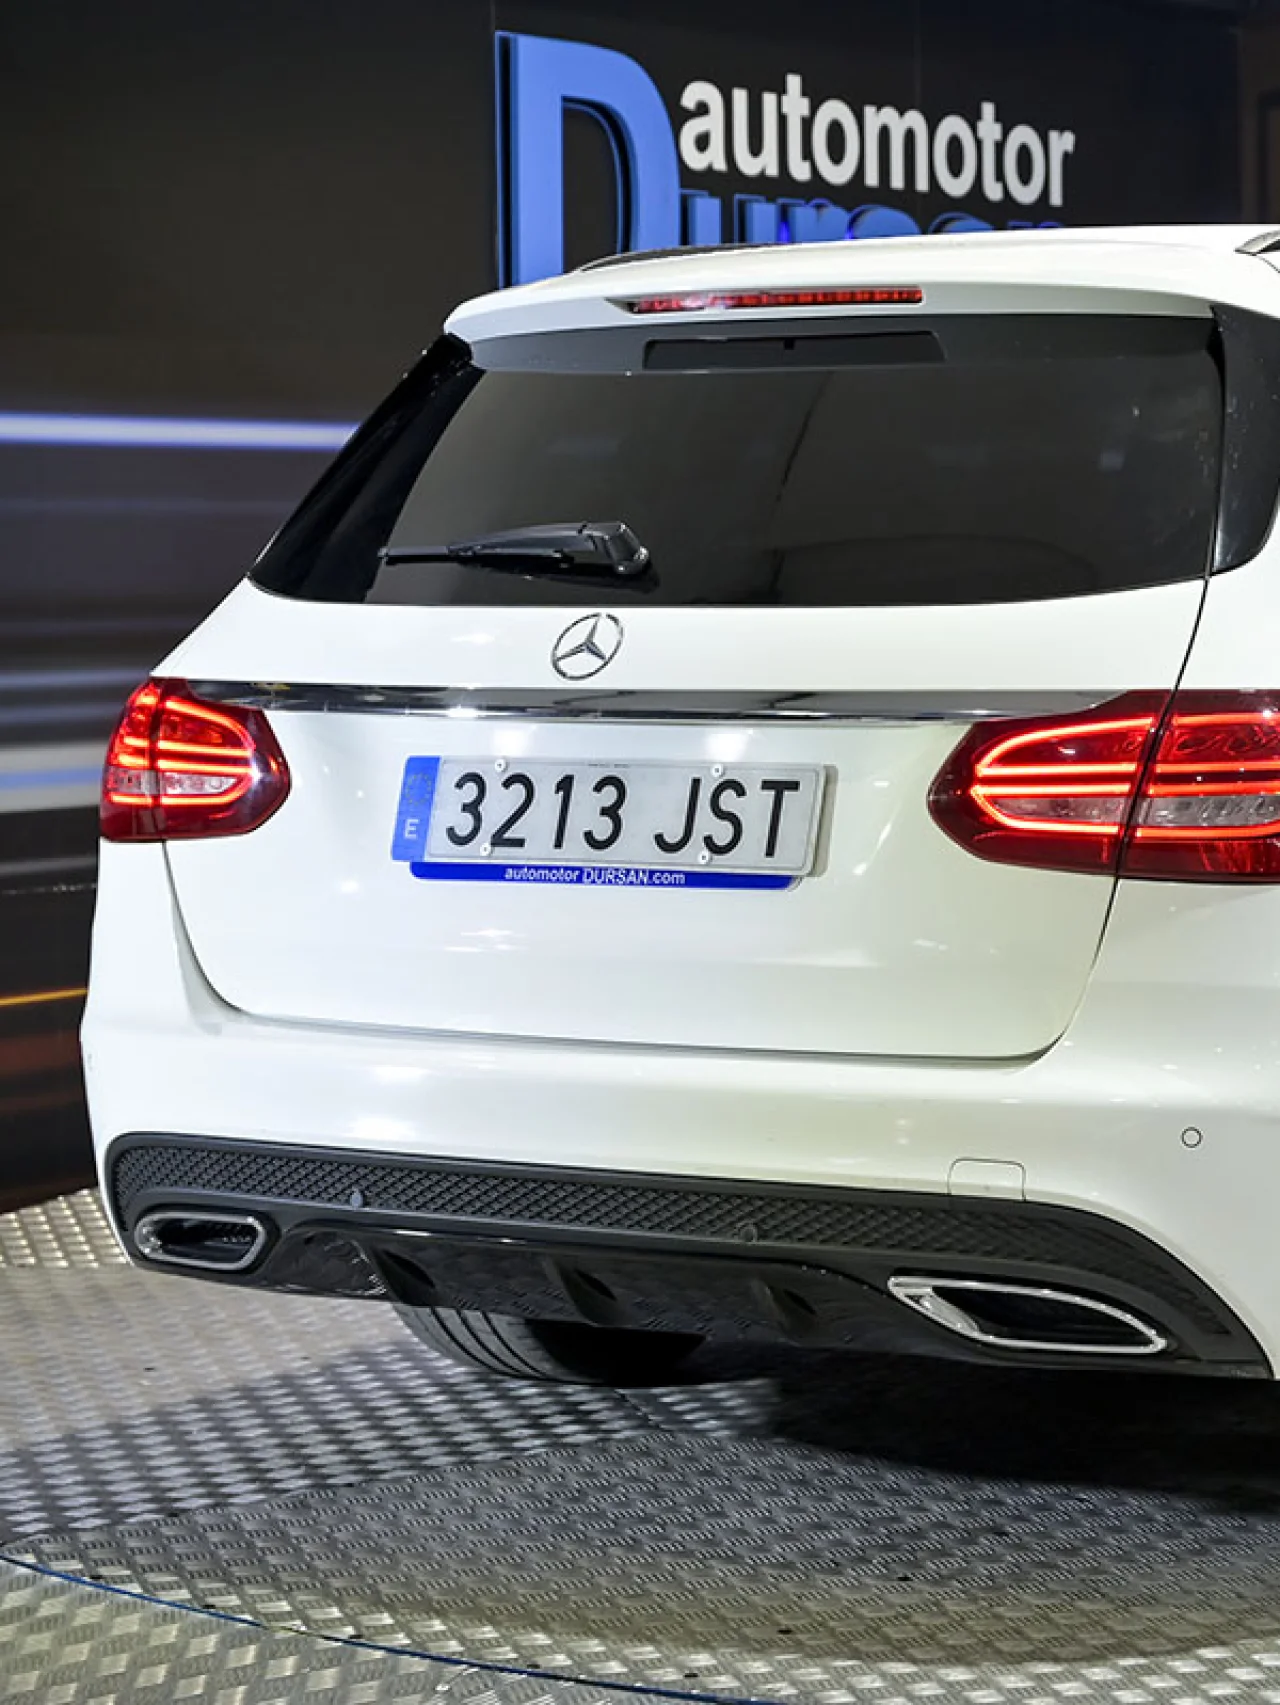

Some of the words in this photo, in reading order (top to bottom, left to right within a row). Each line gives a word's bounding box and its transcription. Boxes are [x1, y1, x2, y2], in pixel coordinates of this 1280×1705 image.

[679, 73, 1076, 207] automotor
[403, 818, 420, 840] E
[445, 772, 629, 850] 3213
[653, 778, 801, 858] JST
[504, 866, 580, 882] automotor
[582, 867, 686, 885] DURSAN.com
